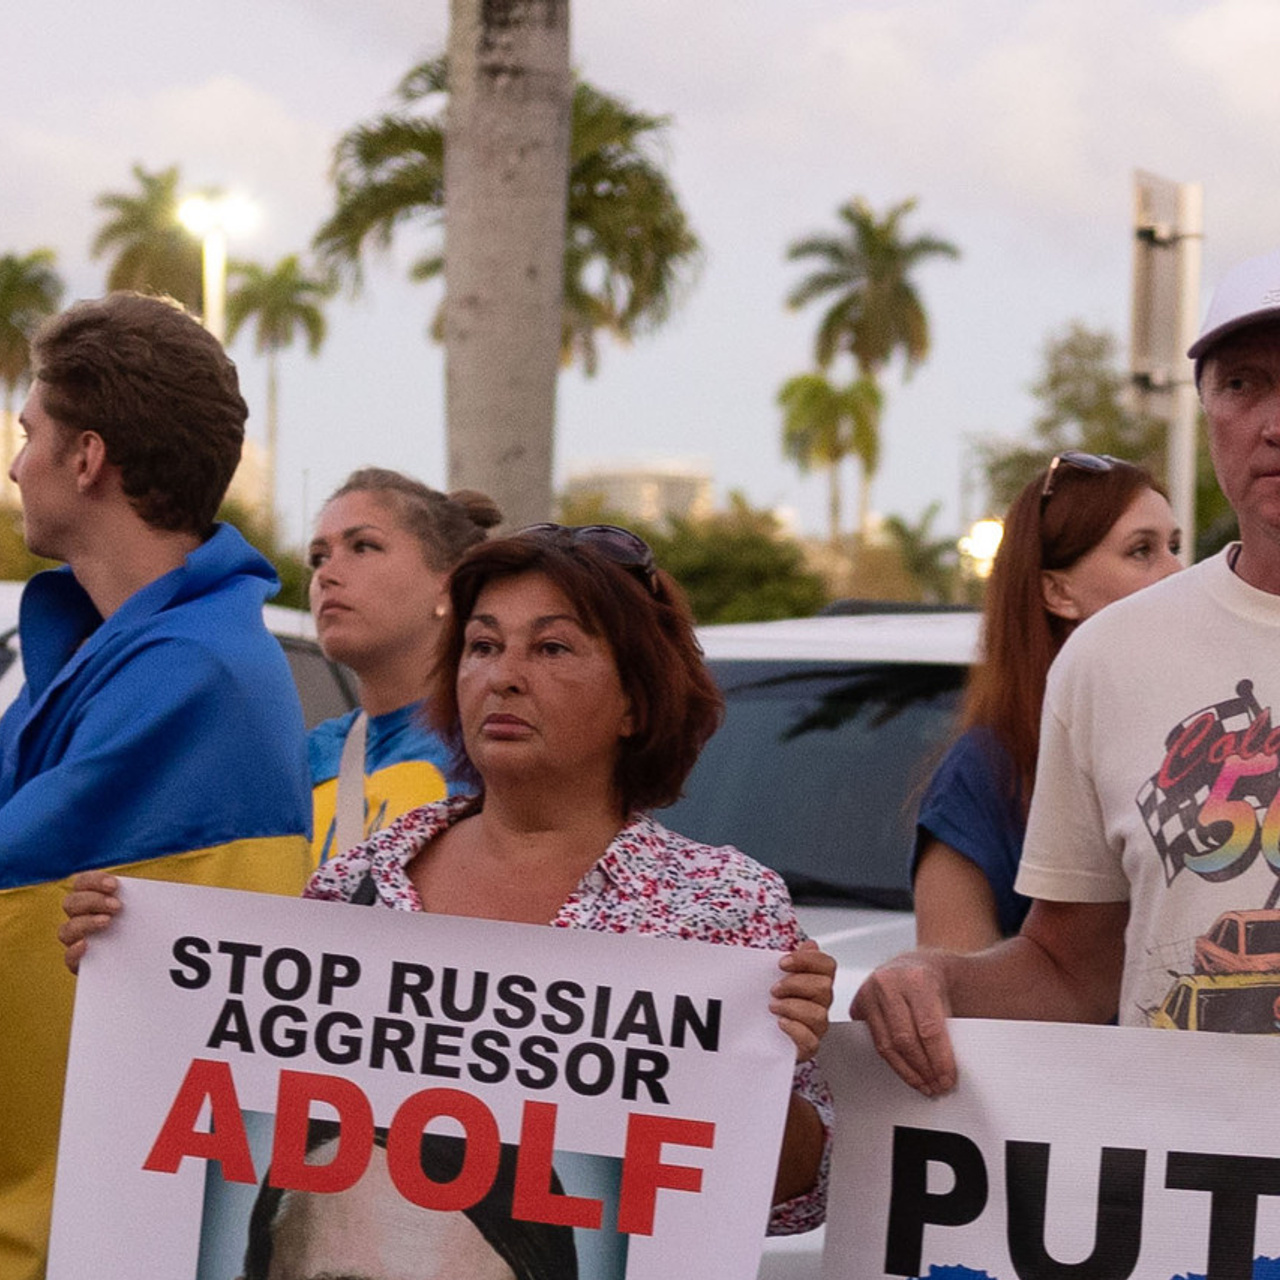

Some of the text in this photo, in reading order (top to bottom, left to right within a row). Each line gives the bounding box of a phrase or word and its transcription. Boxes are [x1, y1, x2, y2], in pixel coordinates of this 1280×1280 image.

[169, 936, 722, 1052] STOP RUSSIAN
[207, 999, 670, 1104] AGGRESSOR
[142, 1058, 715, 1236] ADOLF
